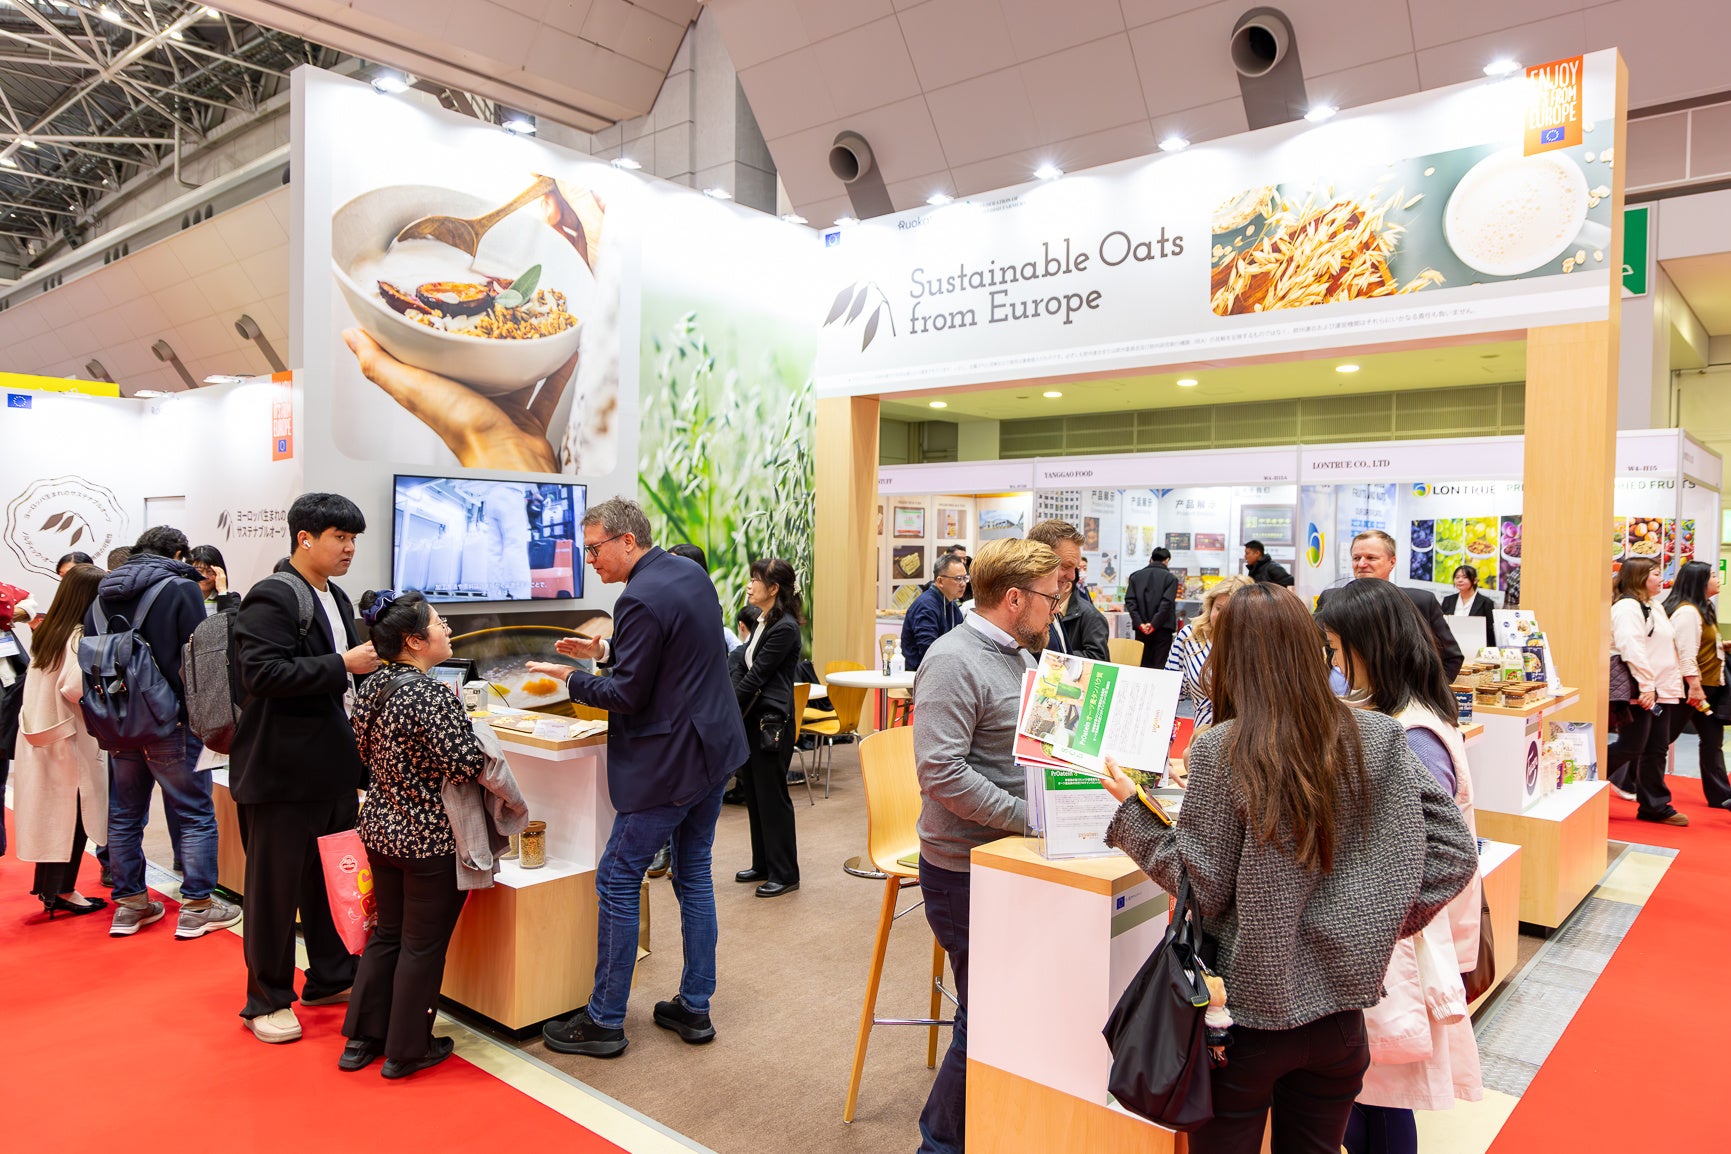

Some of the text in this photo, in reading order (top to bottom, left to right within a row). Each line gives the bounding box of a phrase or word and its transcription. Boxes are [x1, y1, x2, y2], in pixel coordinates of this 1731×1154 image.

[1528, 101, 1576, 130] EUROPE
[910, 227, 1184, 299] Sustainable Oats
[909, 289, 1103, 335] from Europe
[1312, 461, 1352, 470] LONTRUE
[1373, 459, 1390, 468] LTD
[1044, 472, 1074, 480] YANGGAO
[1432, 484, 1496, 496] LONTRUE
[1650, 479, 1696, 490] FRUTS
[236, 510, 286, 522] ヨーロッパ生まれの
[236, 526, 286, 539] サステナブルオーツ
